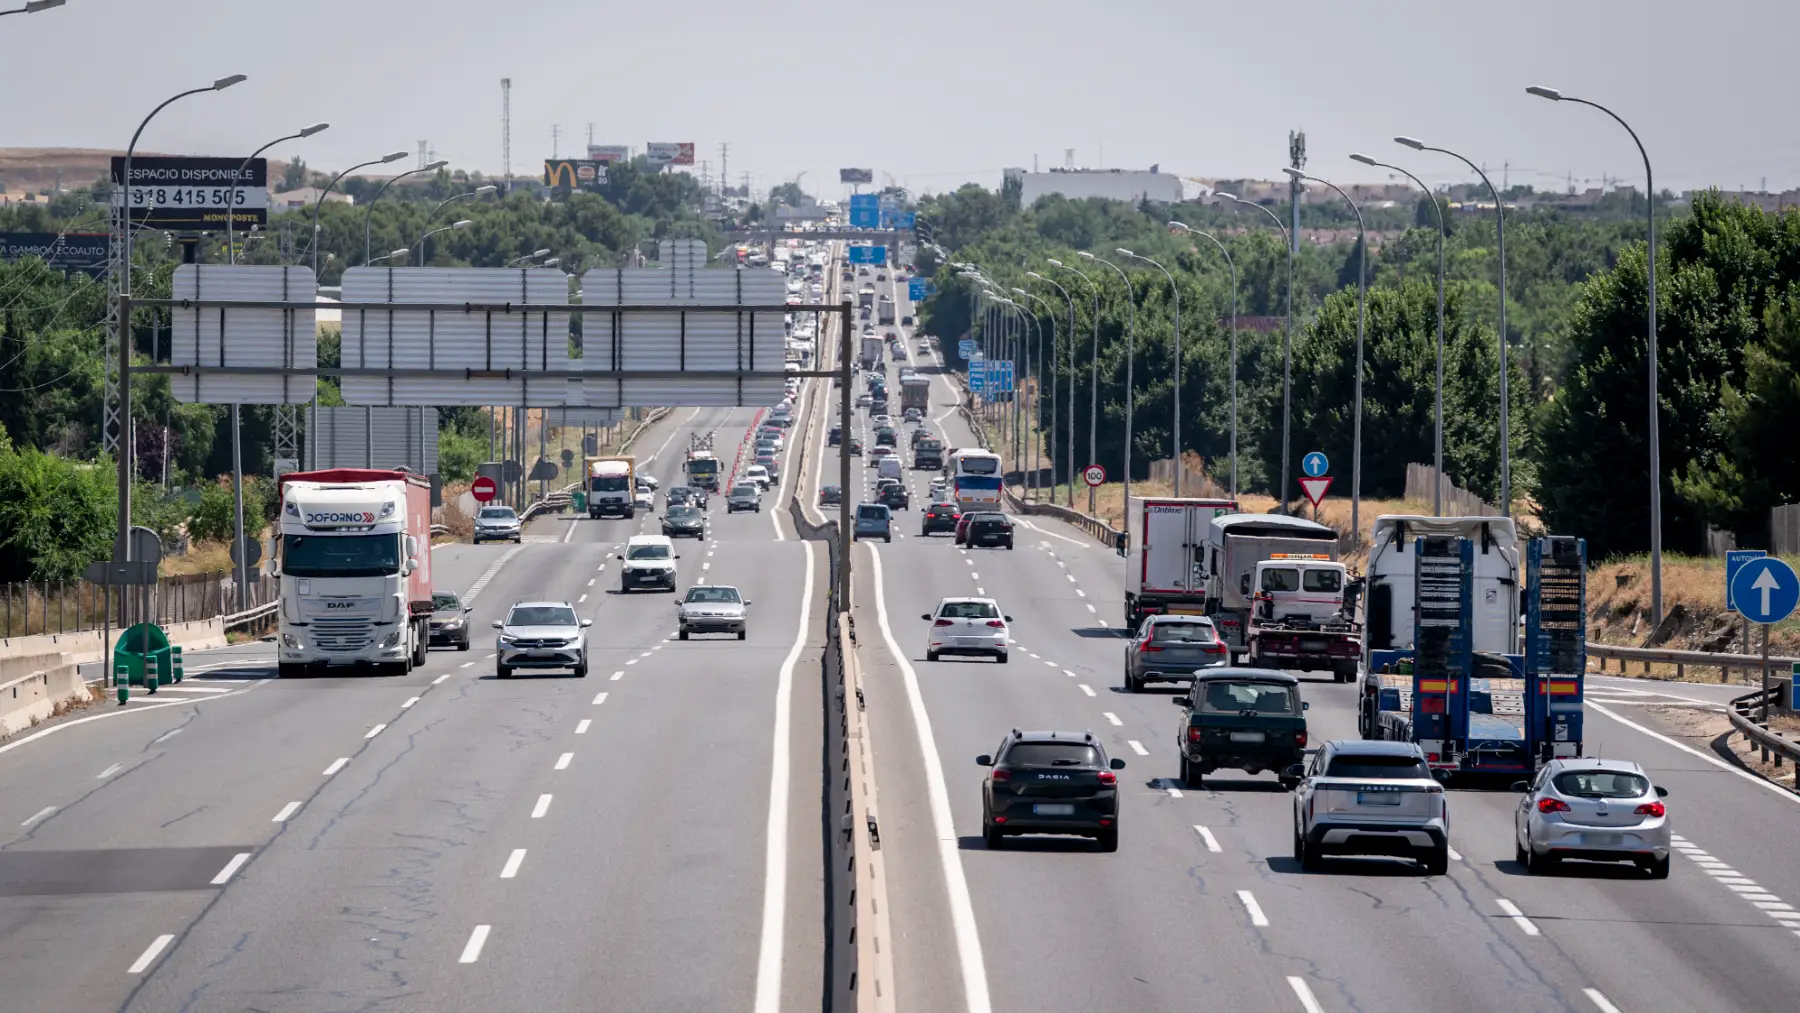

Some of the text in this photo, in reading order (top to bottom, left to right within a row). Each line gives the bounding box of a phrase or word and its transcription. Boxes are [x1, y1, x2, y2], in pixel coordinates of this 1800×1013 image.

[128, 168, 254, 180] ESPACIO DISPONIBLE
[133, 189, 245, 205] 918 415 505
[9, 245, 55, 255] GAMBOA
[56, 246, 105, 256] ECOAUTO
[1088, 472, 1102, 480] 100
